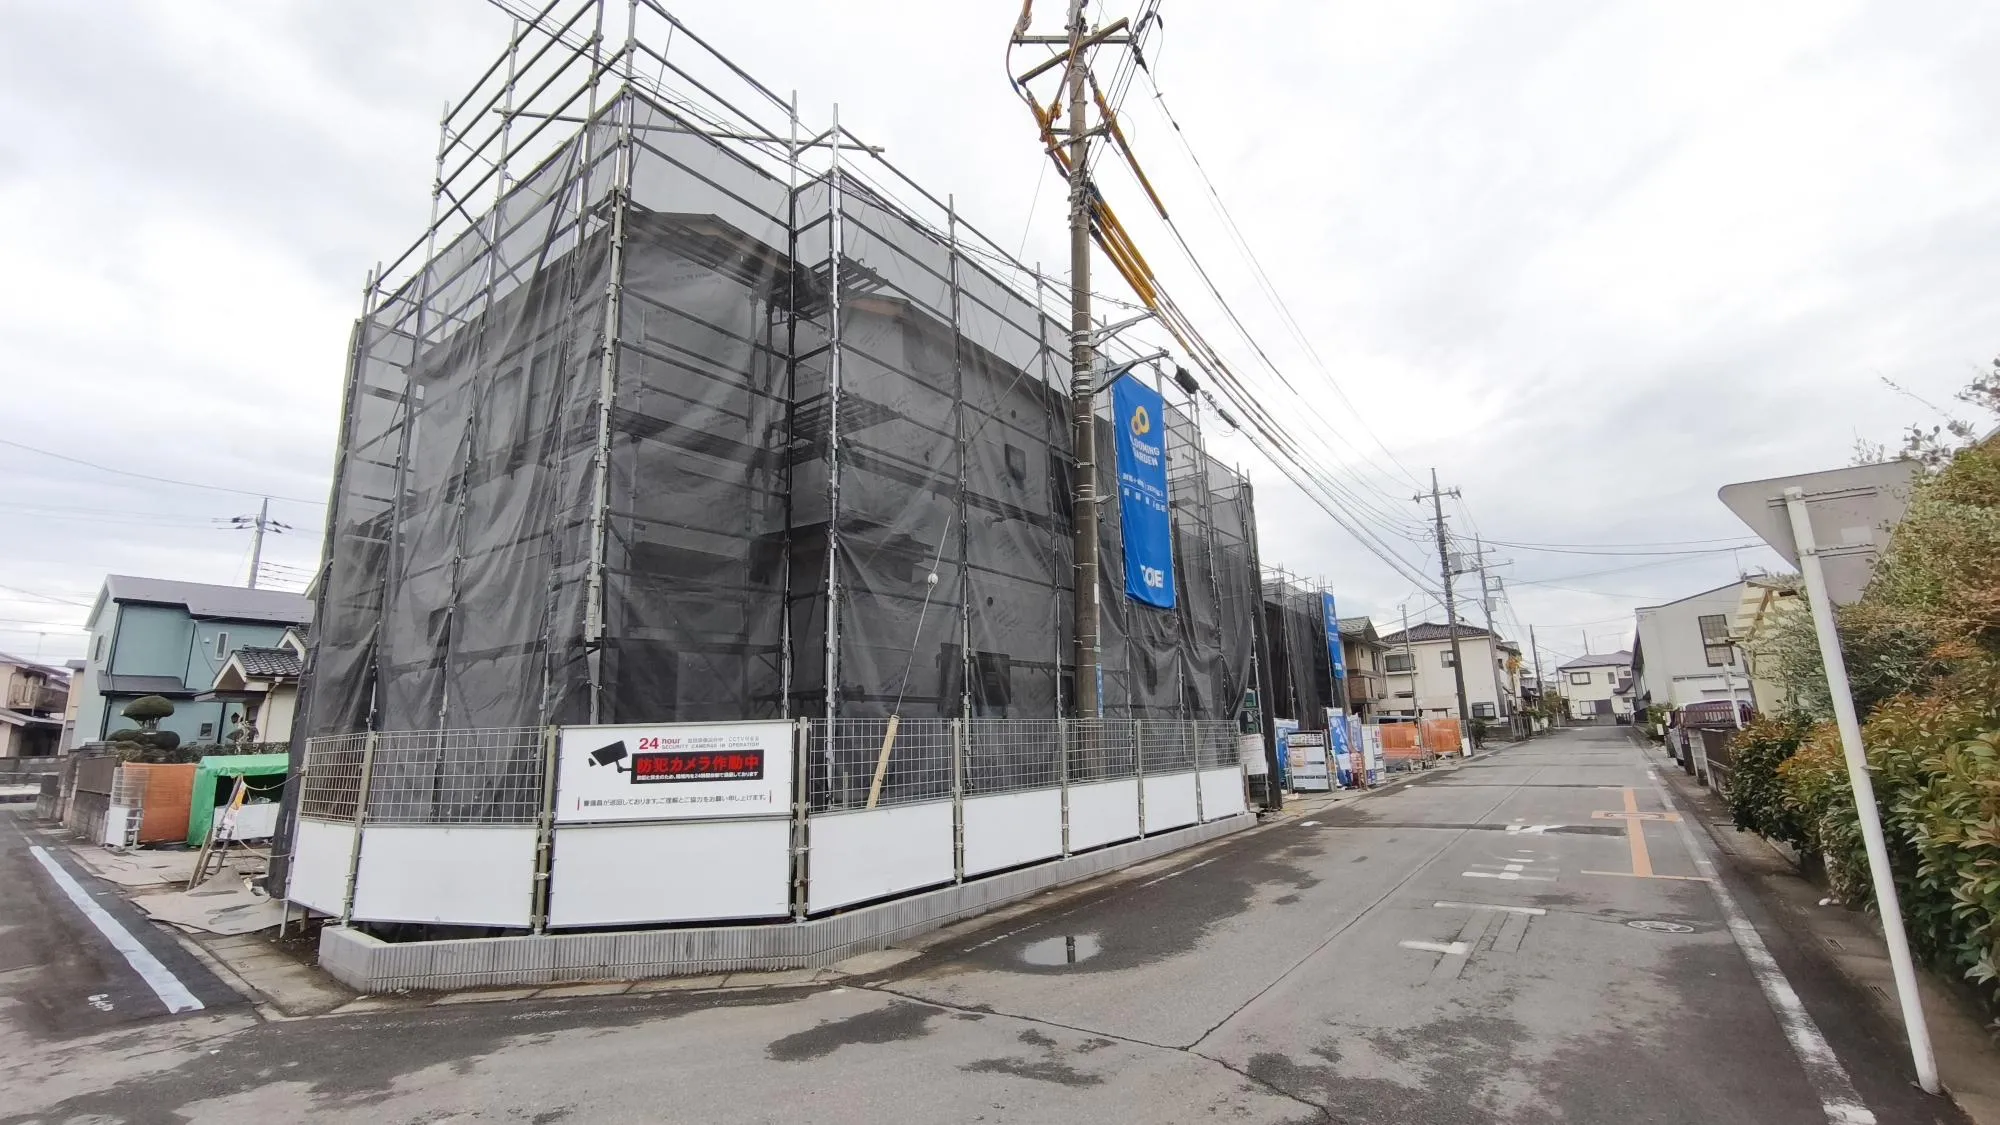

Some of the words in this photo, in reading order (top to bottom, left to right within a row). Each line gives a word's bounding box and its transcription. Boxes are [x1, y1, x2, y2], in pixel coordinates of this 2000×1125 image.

[639, 737, 659, 749] 24
[636, 754, 759, 773] 防犯カメラ作動中
